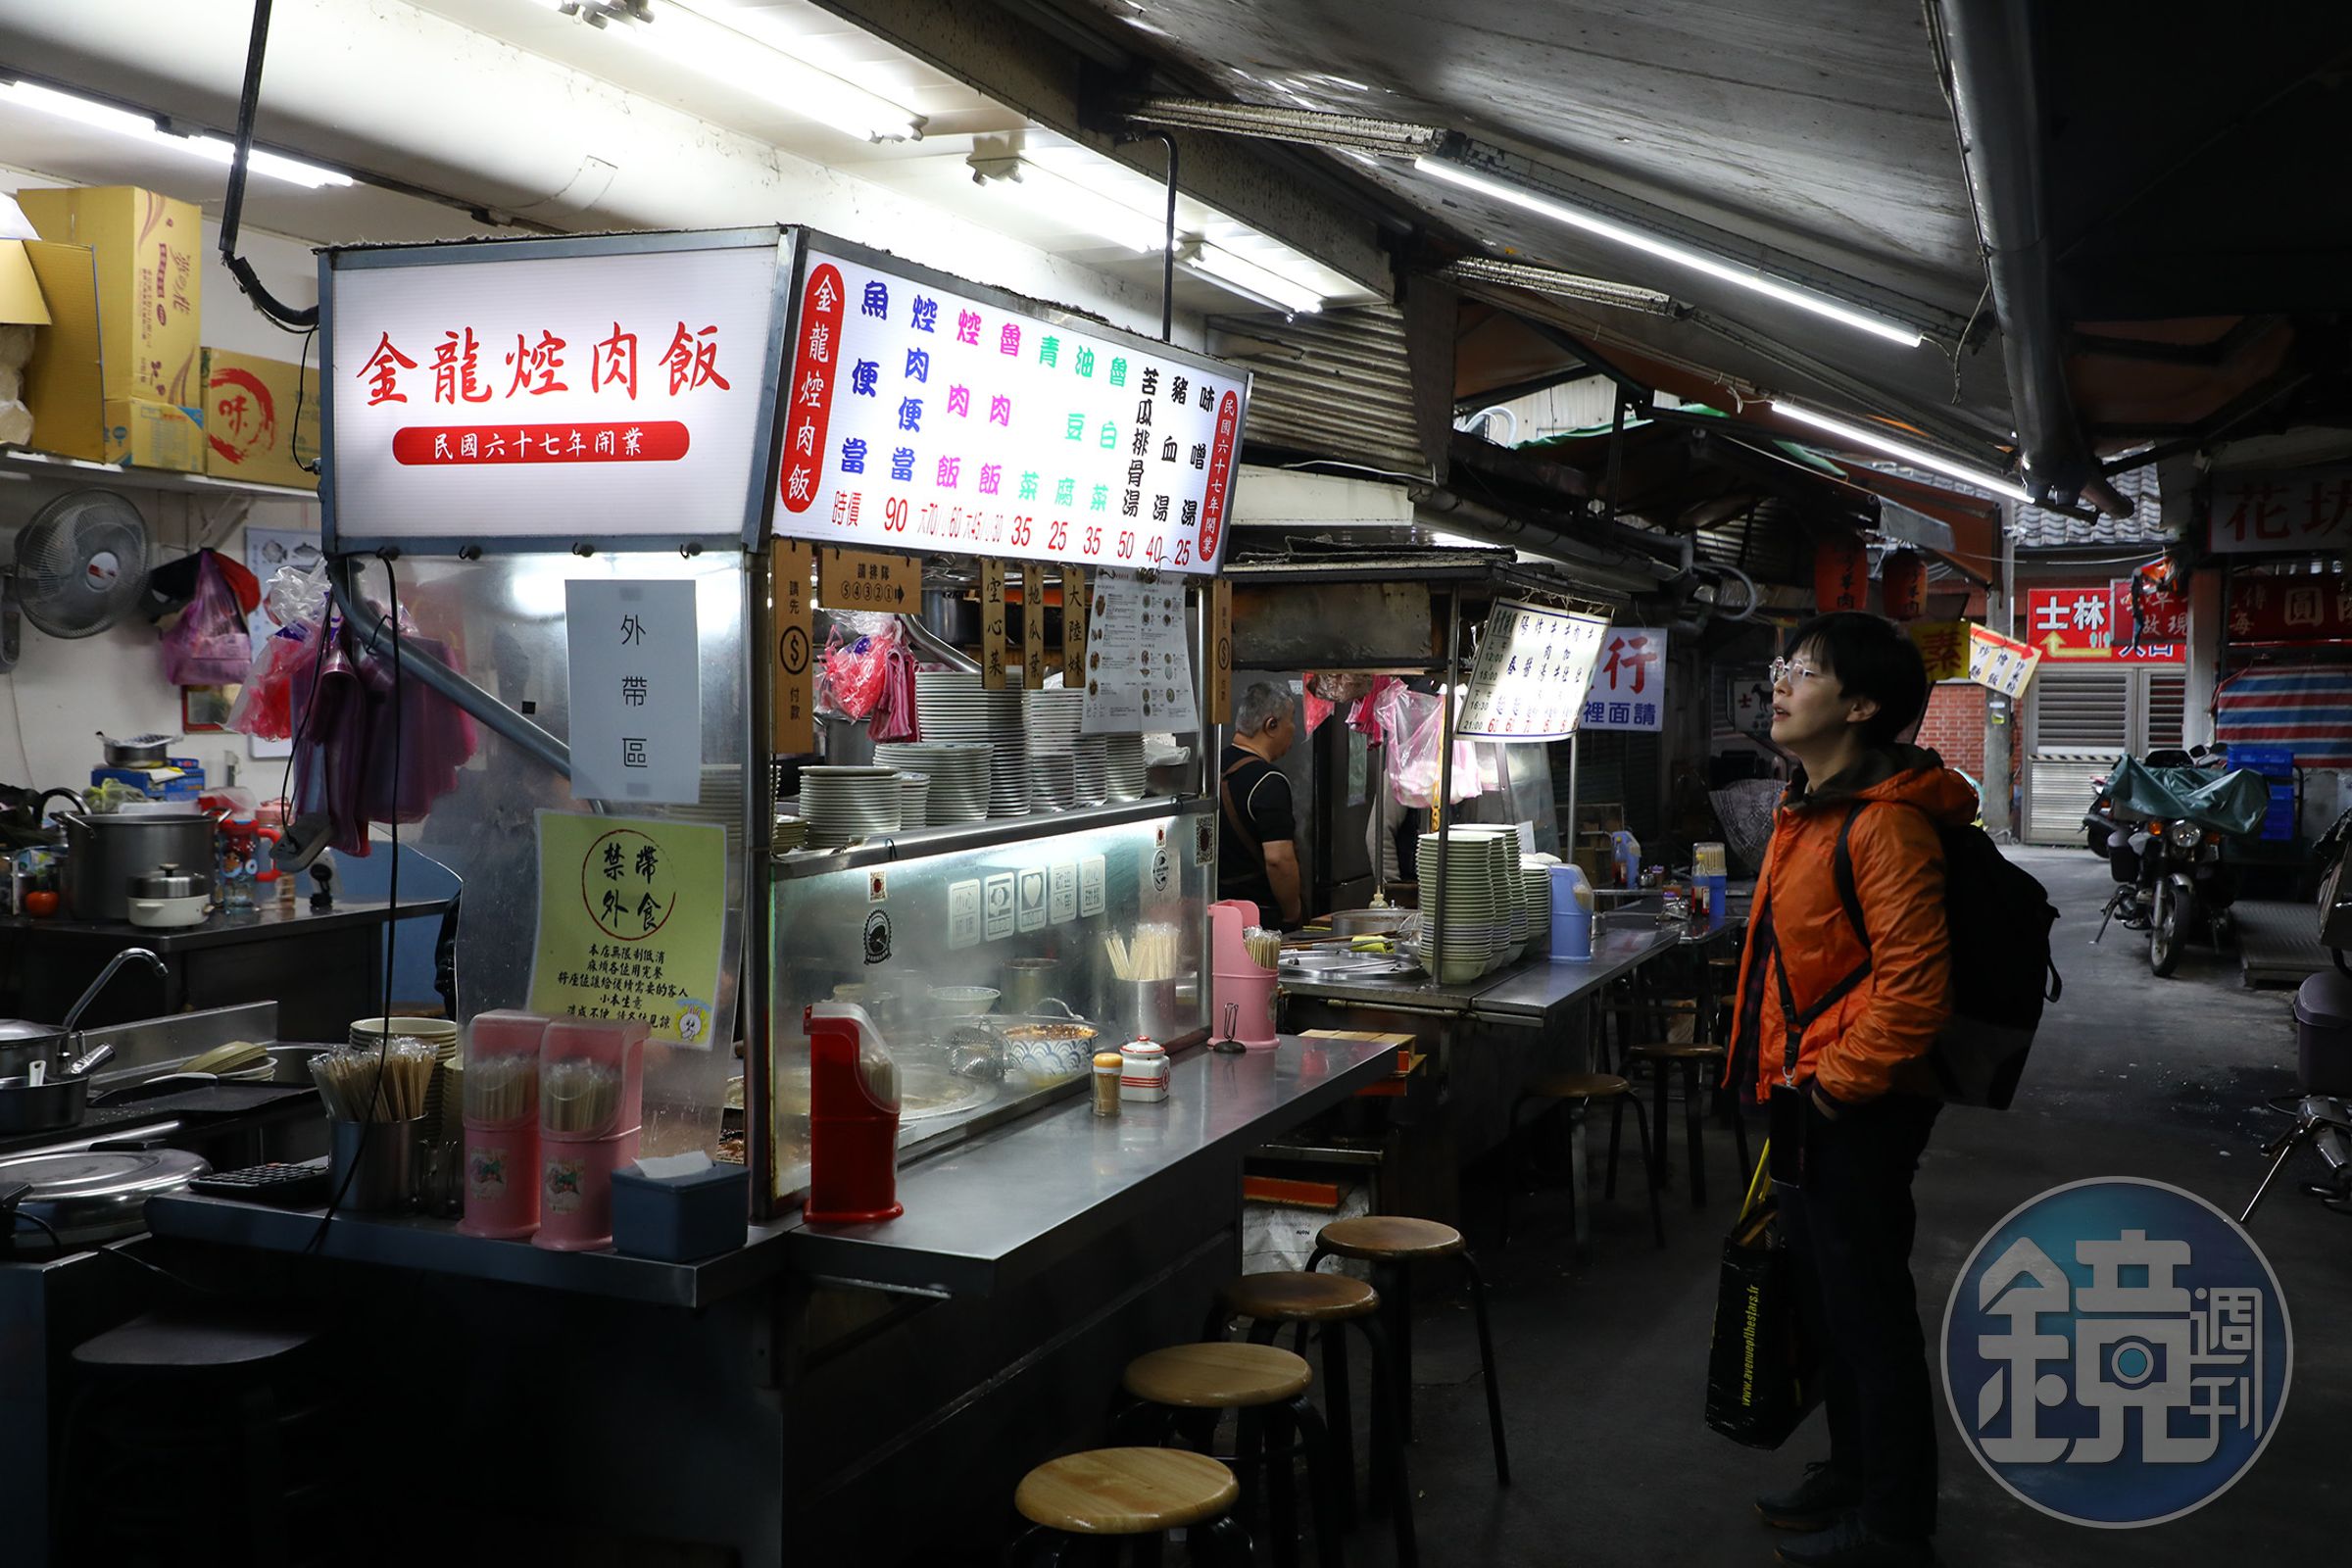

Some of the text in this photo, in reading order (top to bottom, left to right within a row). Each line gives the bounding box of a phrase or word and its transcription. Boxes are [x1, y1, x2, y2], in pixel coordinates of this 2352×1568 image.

[356, 320, 731, 407] 金龍焢肉飯
[787, 274, 838, 503] 金龍焢肉飯
[841, 280, 889, 475] 魚便當
[891, 294, 939, 482] 焢肉便當
[936, 308, 982, 490] 焢肉飯
[433, 427, 645, 460] 民國六十七年開業
[979, 322, 1021, 496] 魯肉飯
[1018, 335, 1060, 501] 青菜
[1054, 345, 1096, 507] 油豆腐
[1090, 357, 1128, 513] 魯白菜
[1122, 367, 1159, 517] 苦瓜排骨湯
[1152, 375, 1189, 522] 豬血湯
[1181, 385, 1215, 527] 味噌湯
[1202, 399, 1235, 554] 民國六十七年開業
[832, 490, 862, 527] 時價
[884, 497, 907, 532] 90
[1010, 514, 1032, 547] 35
[1048, 520, 1068, 551] 25
[1083, 525, 1102, 556] 35
[1117, 530, 1135, 560] 50
[1145, 535, 1163, 564] 40
[858, 564, 891, 581] 請排隊
[1174, 539, 1192, 566] 25
[789, 581, 800, 614] 請先
[986, 577, 1004, 677] 空心菜
[1028, 583, 1042, 678] 地瓜葉
[1068, 585, 1083, 675] 大陸妹
[2035, 595, 2106, 631] 士林
[620, 613, 648, 768] 外帶區
[790, 688, 801, 720] 付款
[1584, 701, 1655, 725] 裡面請
[604, 842, 659, 884] 禁帶
[601, 889, 662, 932] 外食
